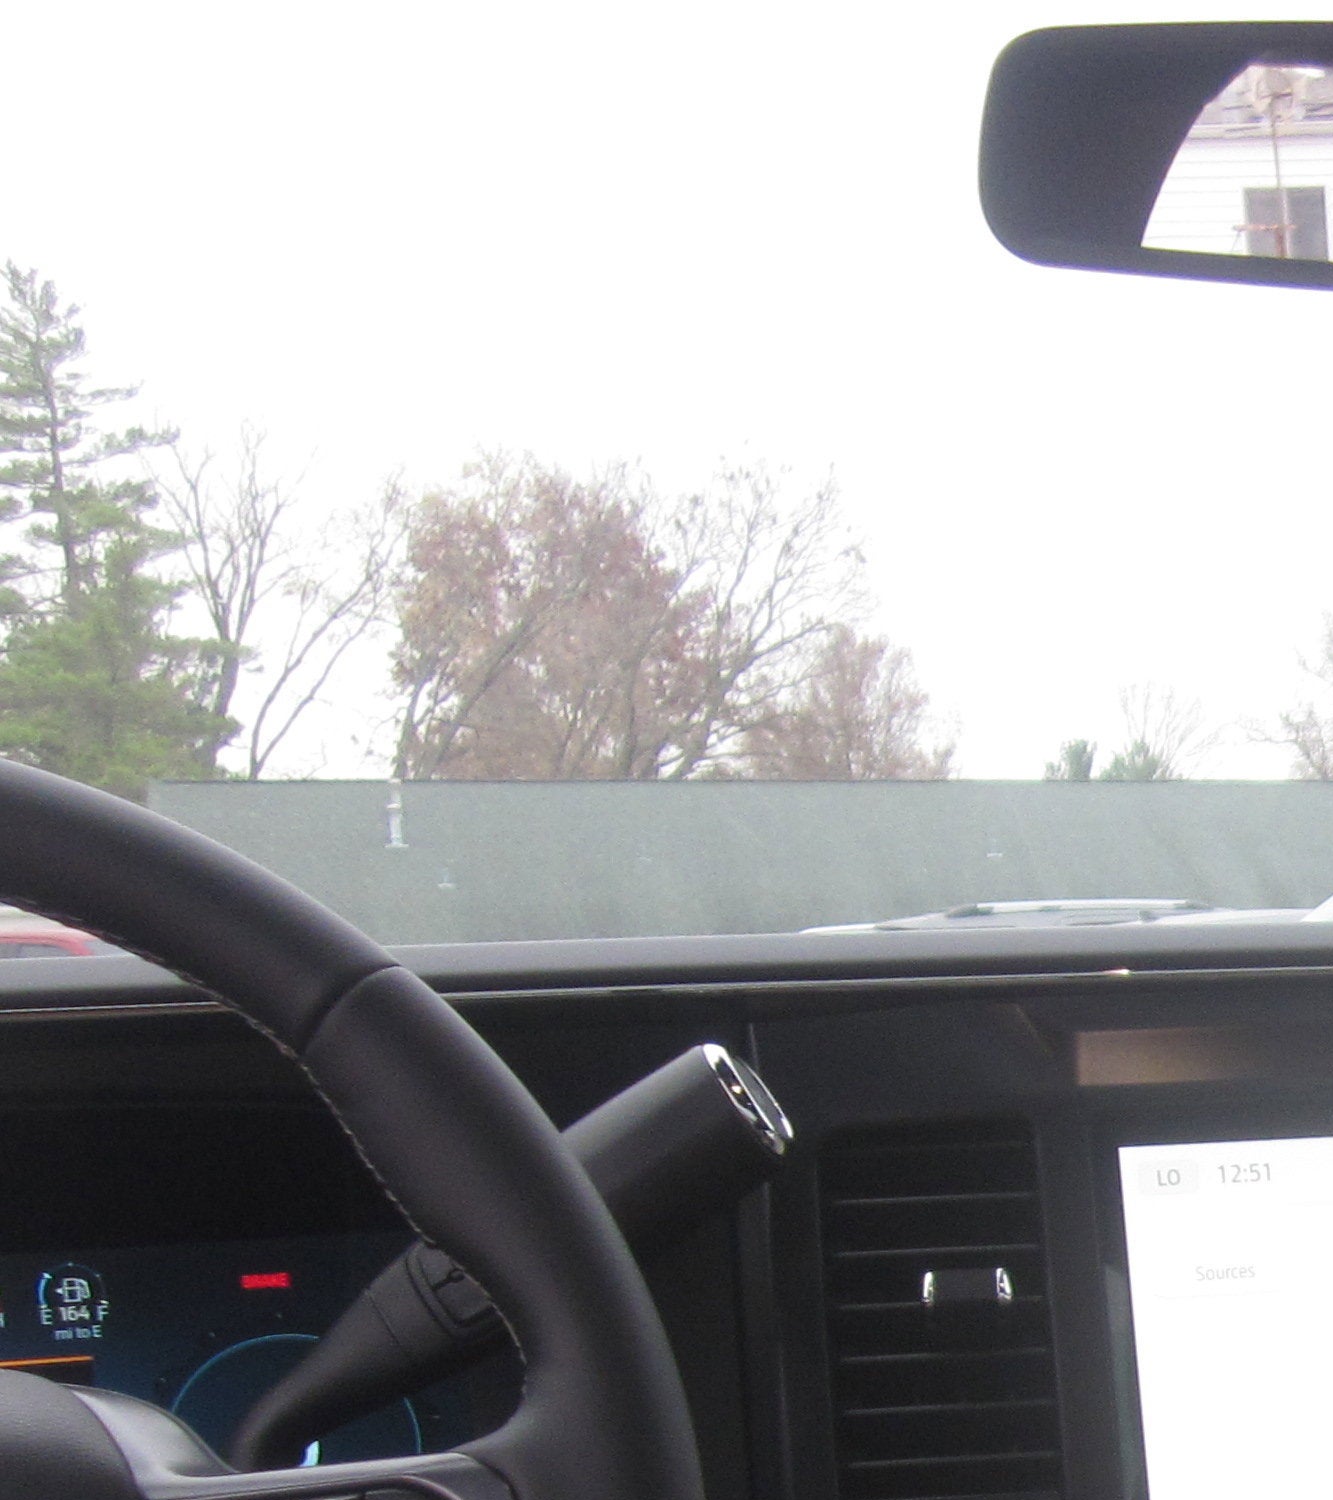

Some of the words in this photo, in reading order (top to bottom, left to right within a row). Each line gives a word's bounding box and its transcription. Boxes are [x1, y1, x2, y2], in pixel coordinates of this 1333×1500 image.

[1156, 1168, 1181, 1187] LO
[1217, 1162, 1273, 1185] 12:51
[1195, 1263, 1257, 1282] Sources
[41, 1309, 52, 1326] E
[97, 1305, 109, 1321] F
[55, 1328, 73, 1341] mi
[92, 1325, 102, 1338] E
